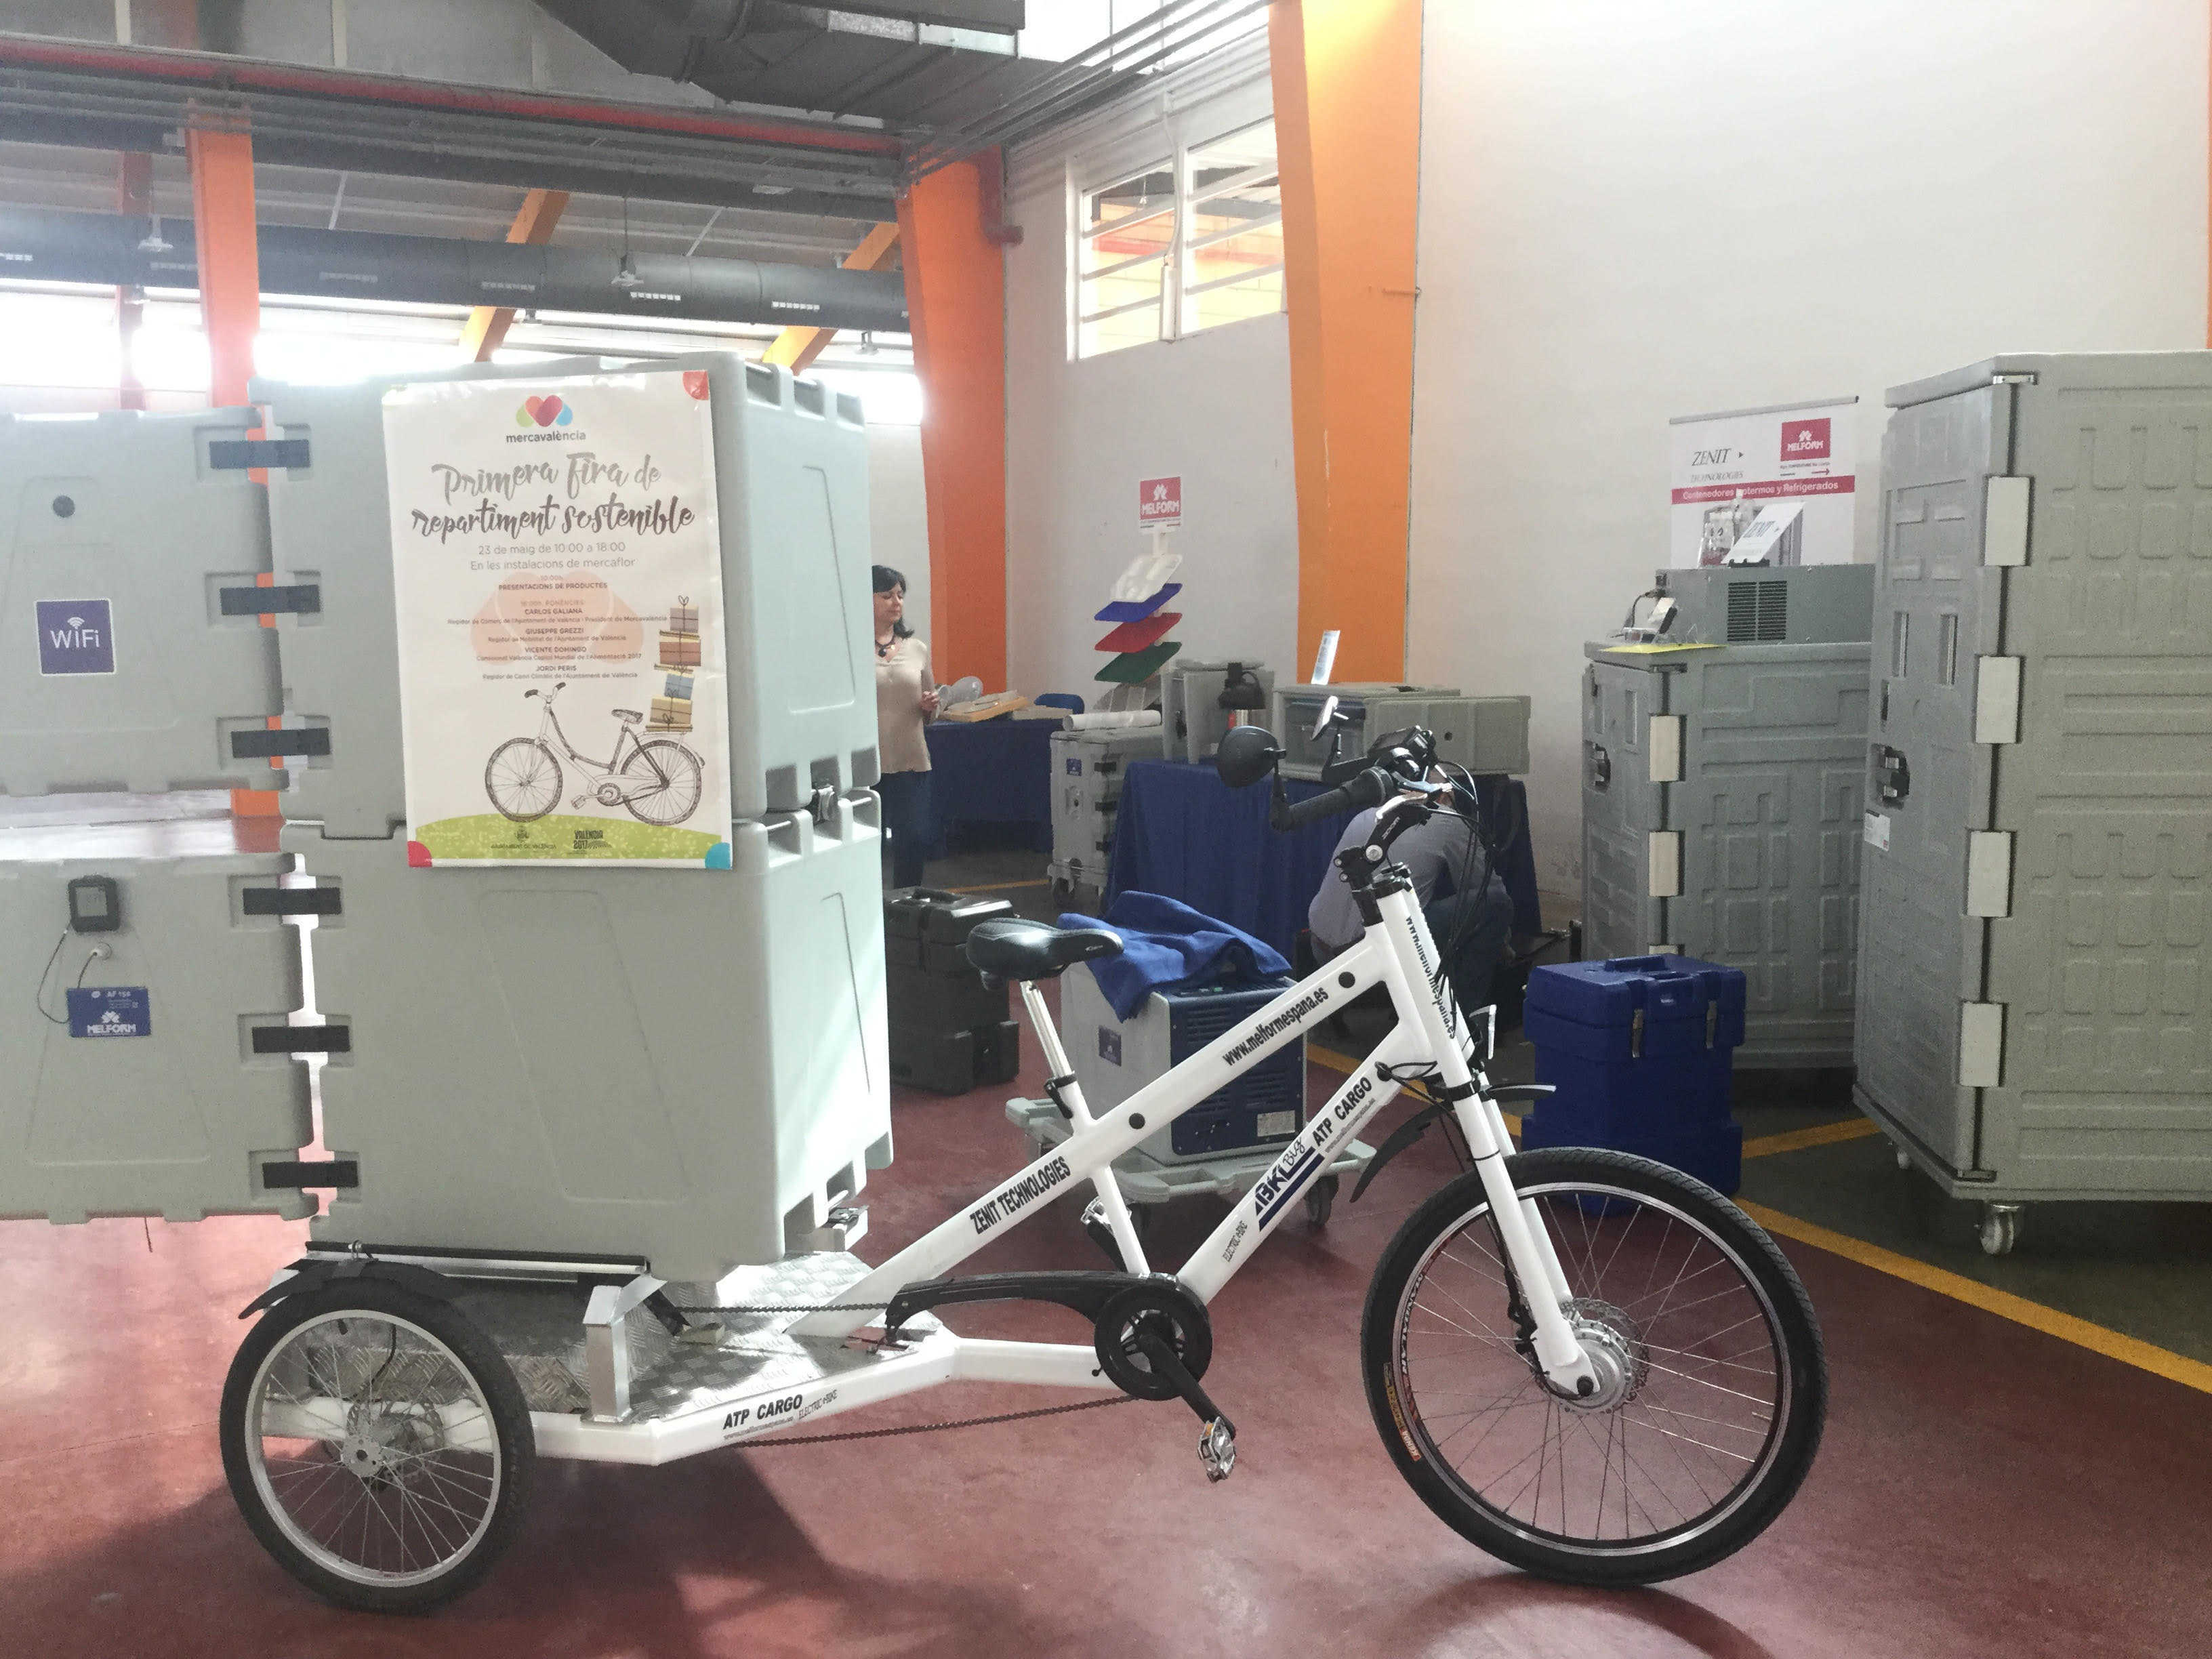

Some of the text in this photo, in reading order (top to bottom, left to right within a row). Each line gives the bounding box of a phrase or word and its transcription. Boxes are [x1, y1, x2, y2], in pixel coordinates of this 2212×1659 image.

[506, 430, 586, 445] mercavalència
[1787, 441, 1824, 452] MELFORM
[1692, 447, 1732, 467] ZENIT
[431, 451, 661, 505] Primera Fira de
[1784, 482, 1839, 494] Refrigerados
[1141, 499, 1180, 516] MELFORM
[411, 491, 695, 544] repartiment sostenible
[478, 545, 491, 555] 23
[493, 544, 508, 555] de
[510, 544, 536, 558] maig
[539, 544, 552, 554] de
[471, 556, 636, 571] En les instalacions de mercaflor
[87, 1024, 137, 1034] MELFORM
[1223, 985, 1330, 1067] www.melformespana.es
[1311, 1117, 1334, 1147] ATP
[1333, 1076, 1373, 1120] CARGO
[969, 1155, 1071, 1235] ZENIT TECHNOLOGIES
[722, 1408, 750, 1430] ATP
[756, 1393, 803, 1420] CARGO
